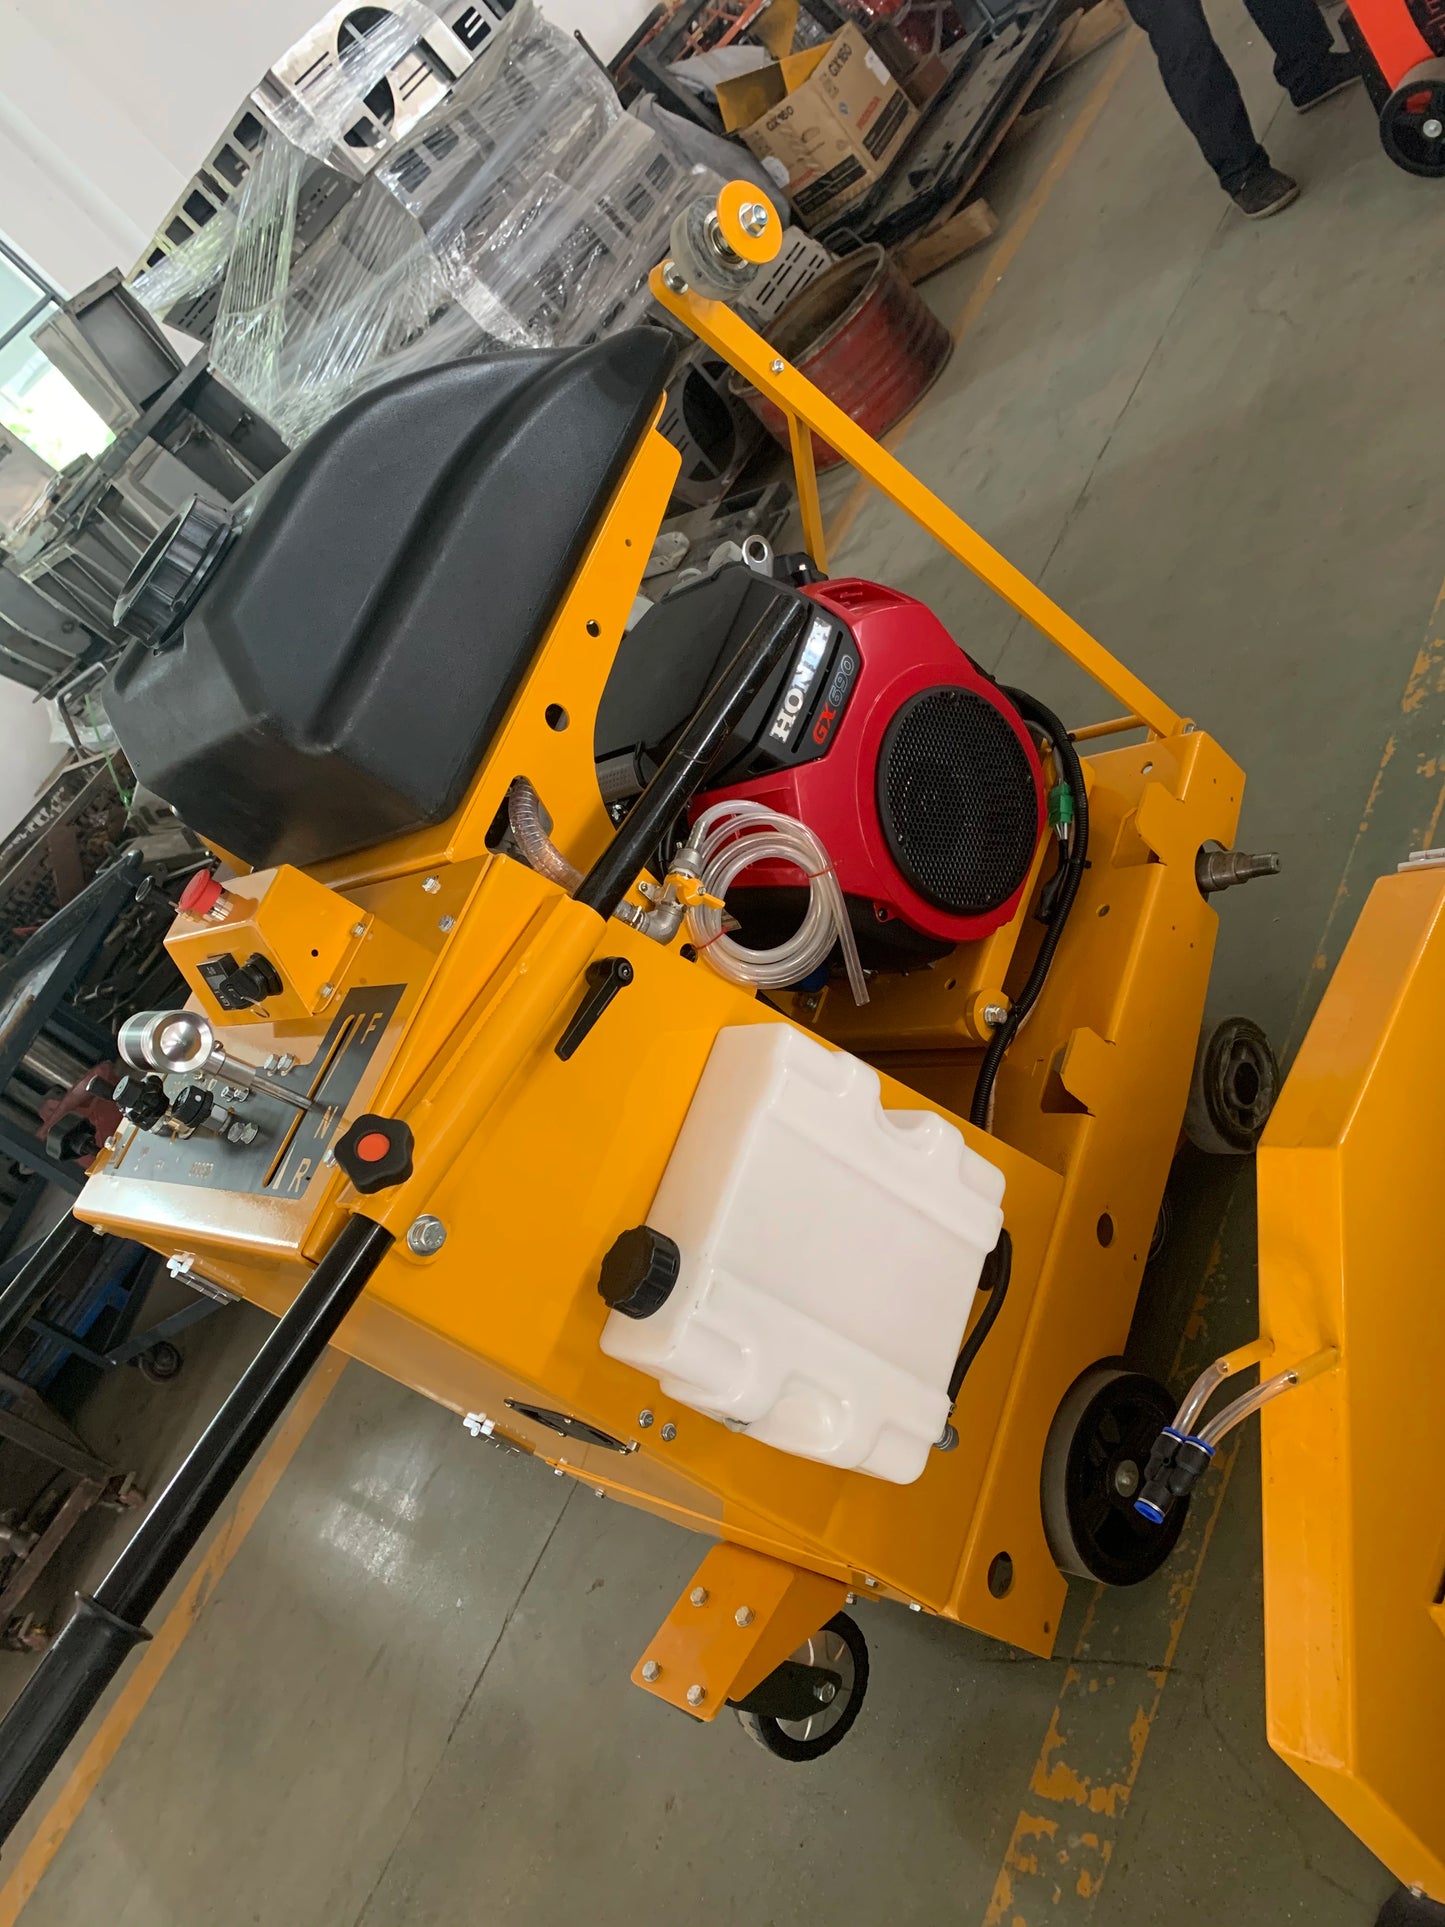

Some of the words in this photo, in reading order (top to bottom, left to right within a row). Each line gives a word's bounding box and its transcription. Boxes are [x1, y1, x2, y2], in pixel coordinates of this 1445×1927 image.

[827, 42, 853, 77] GX160
[360, 1012, 383, 1045] F
[314, 1105, 339, 1139] N
[287, 1157, 311, 1193] R
